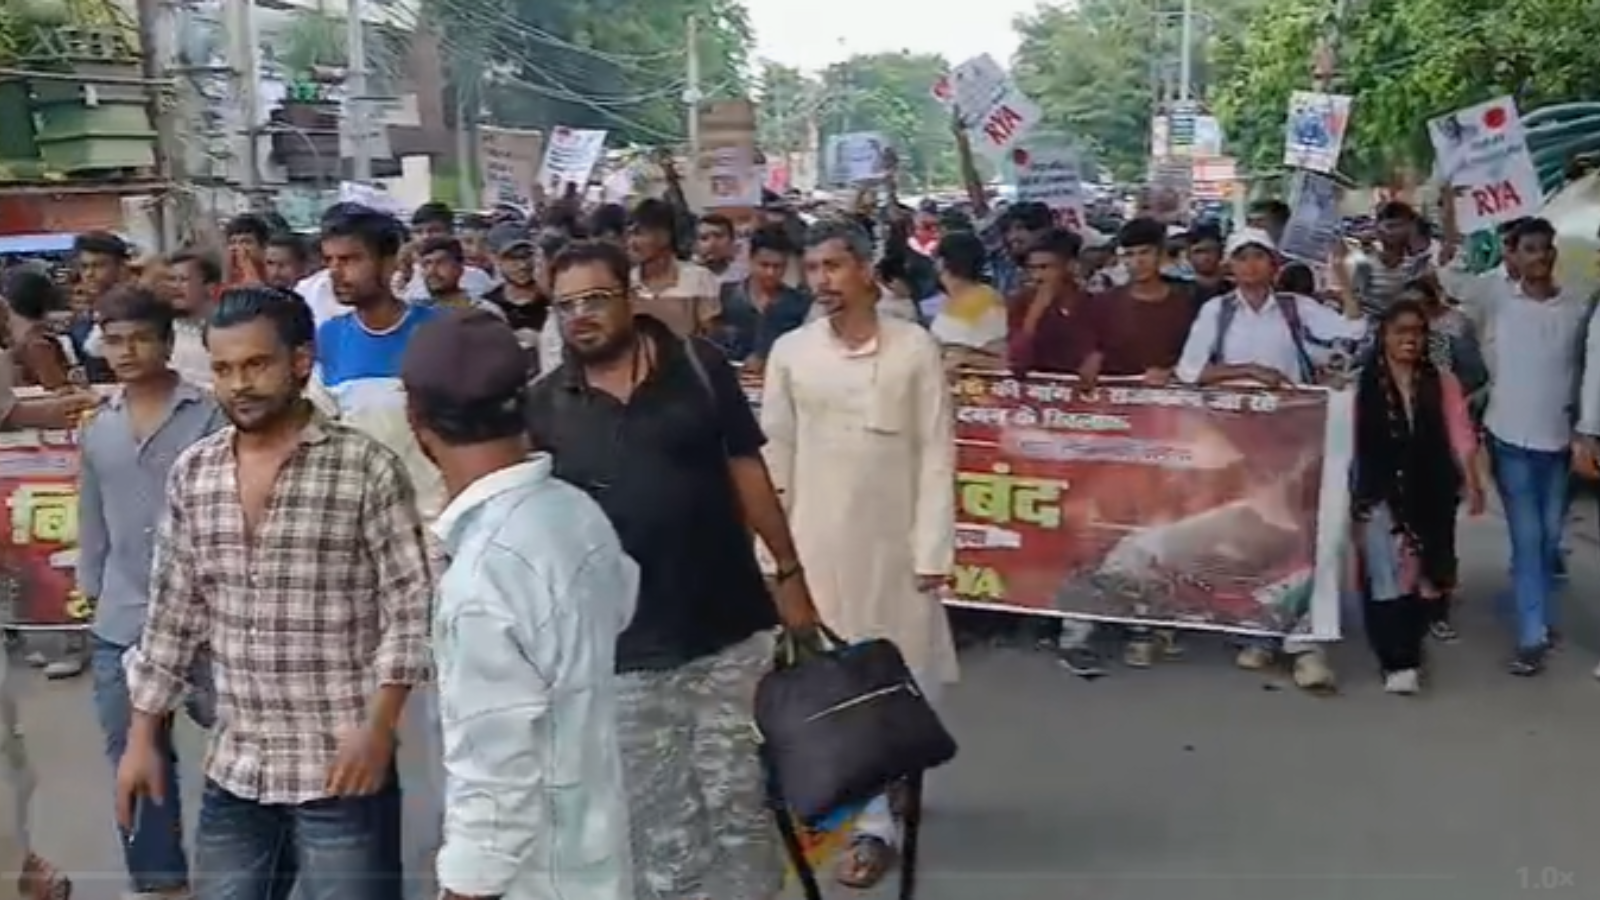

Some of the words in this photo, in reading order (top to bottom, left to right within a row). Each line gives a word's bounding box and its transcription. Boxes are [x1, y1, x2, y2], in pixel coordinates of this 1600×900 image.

[984, 105, 1022, 145] RYA
[1472, 179, 1522, 216] RYA
[956, 462, 1070, 528] बंद
[953, 565, 1006, 598] YA
